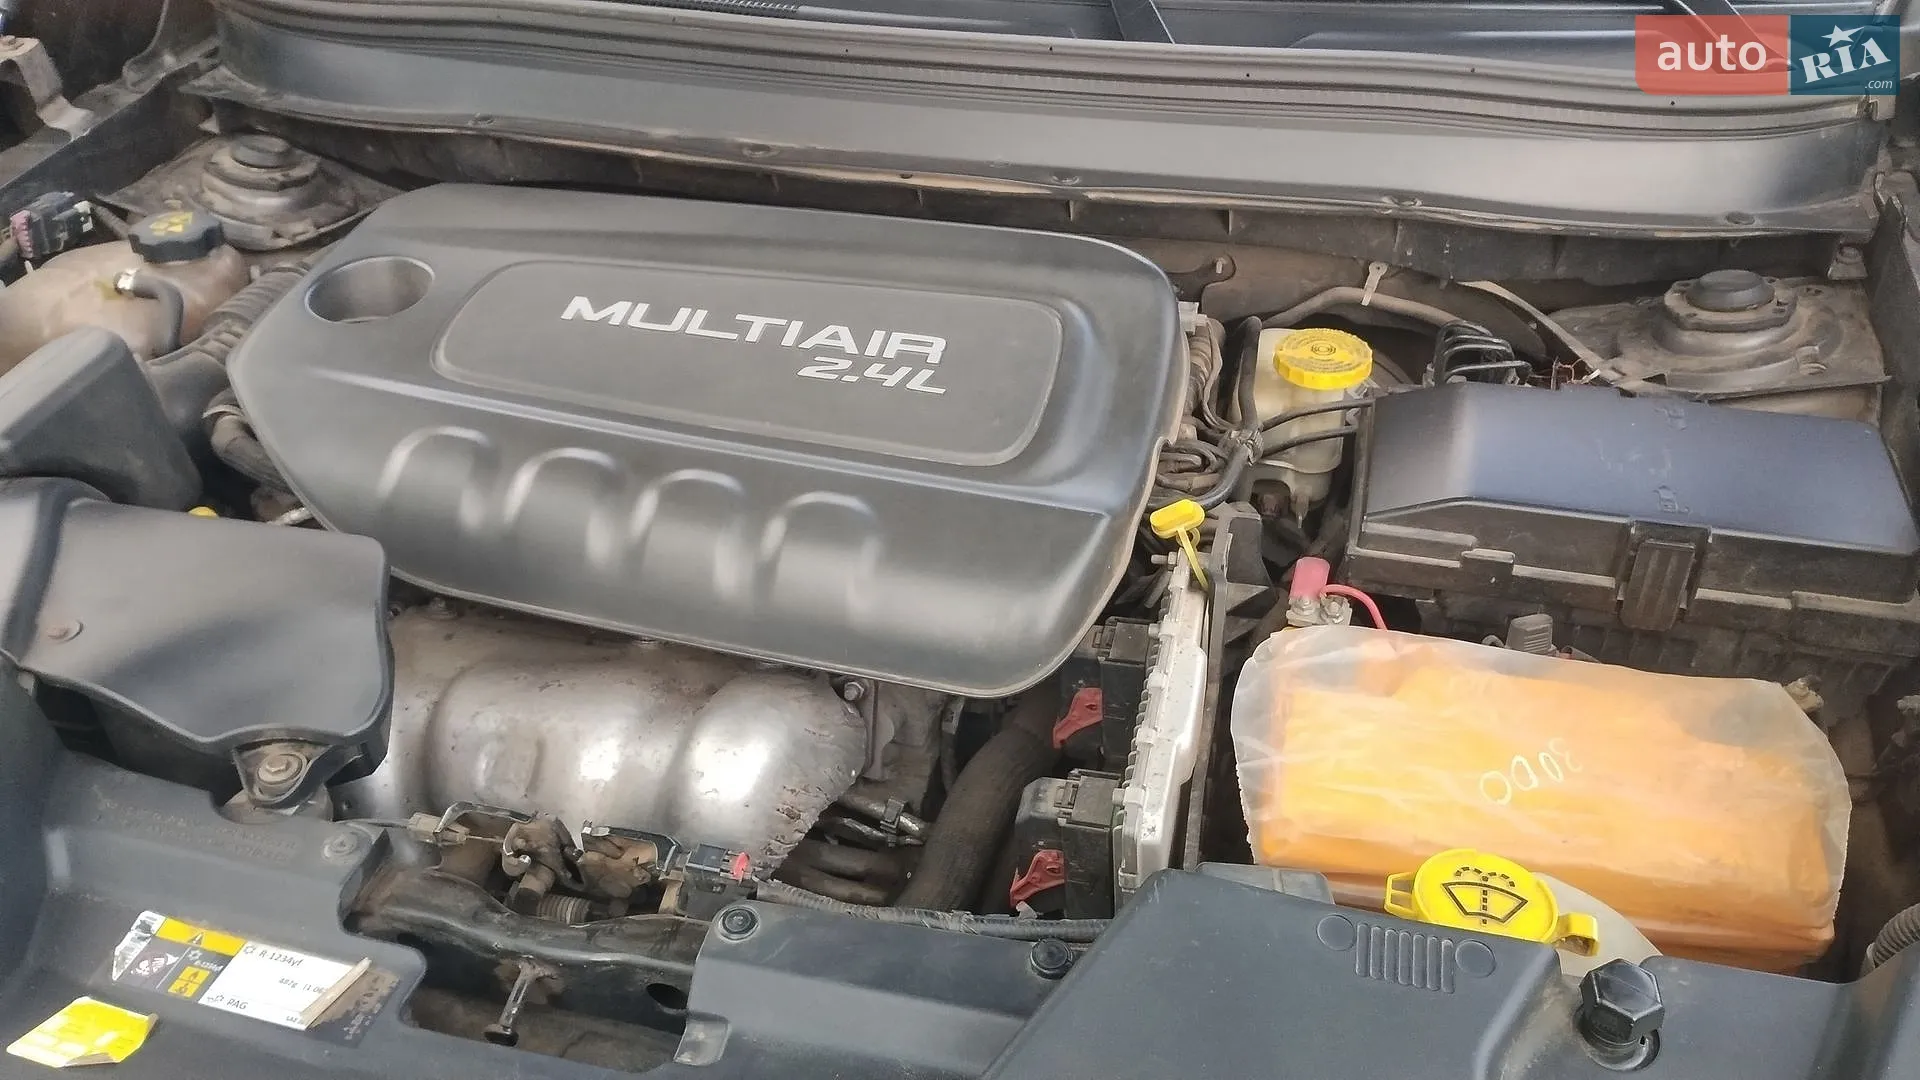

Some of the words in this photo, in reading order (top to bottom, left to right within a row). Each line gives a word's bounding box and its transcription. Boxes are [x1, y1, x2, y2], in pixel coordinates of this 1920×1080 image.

[560, 295, 947, 364] MULTIAIR
[797, 356, 947, 395] 2.4L
[226, 999, 248, 1010] PAG
